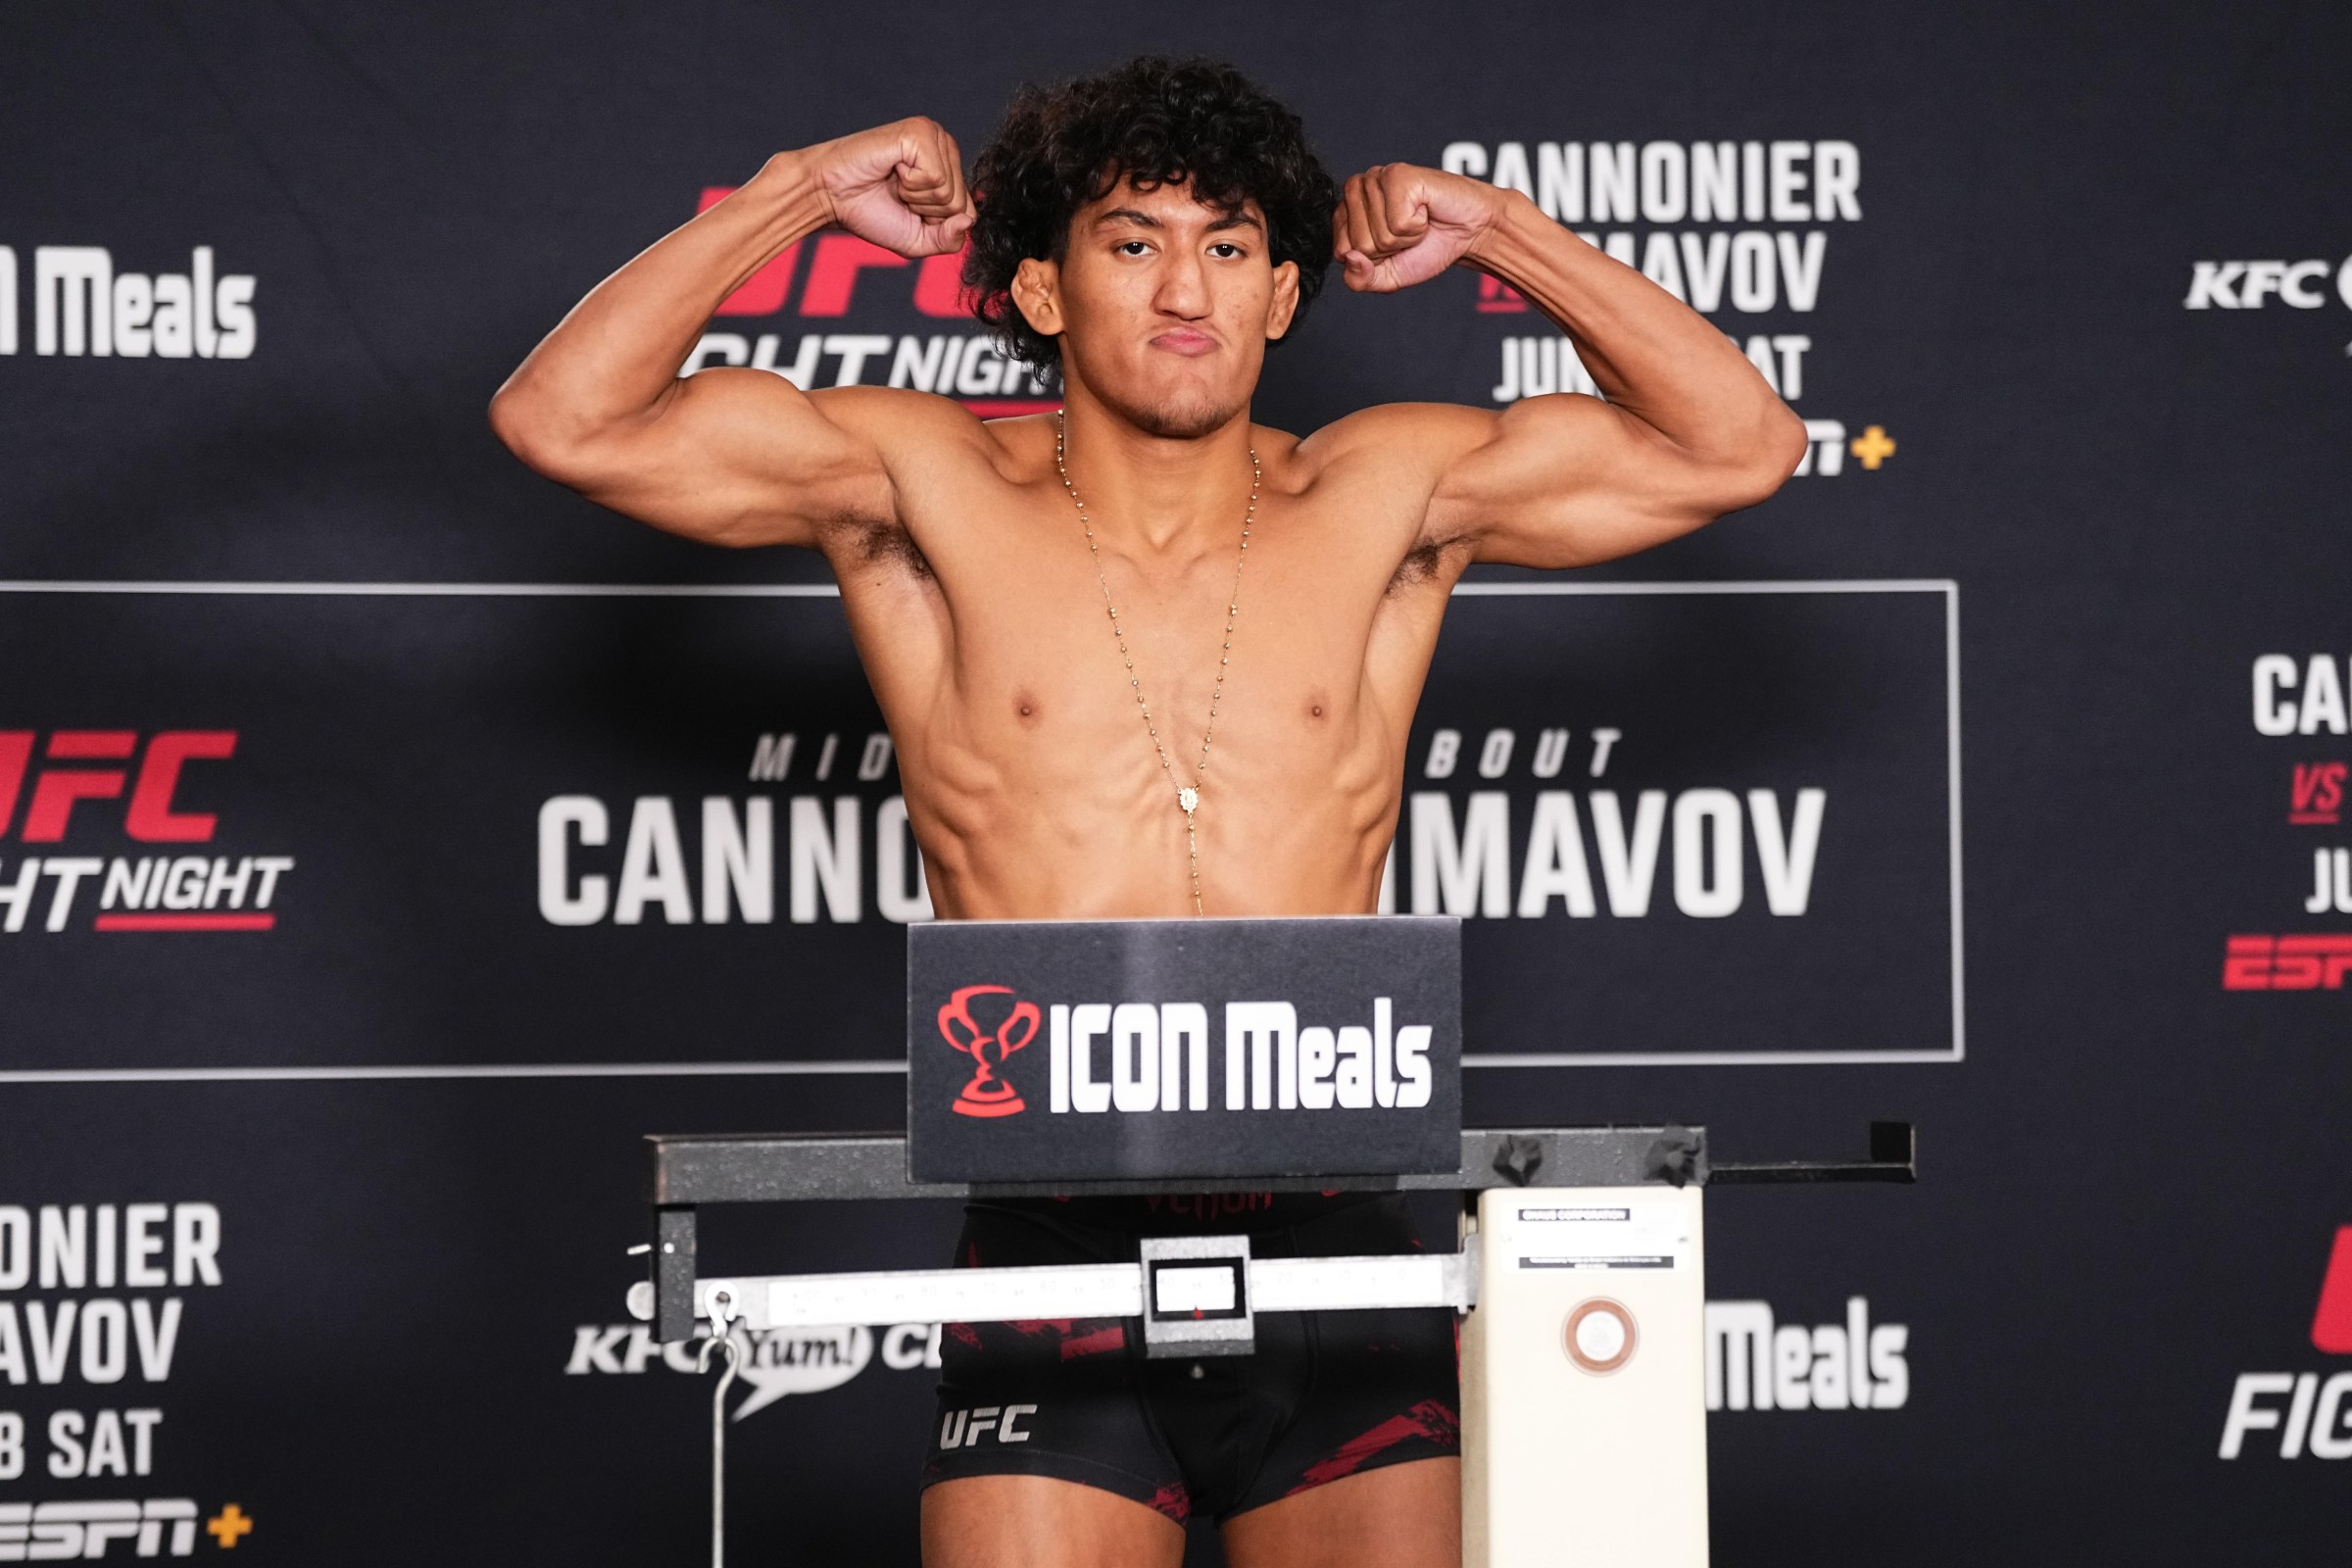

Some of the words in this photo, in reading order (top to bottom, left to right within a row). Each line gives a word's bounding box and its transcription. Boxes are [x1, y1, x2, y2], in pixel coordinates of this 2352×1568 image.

[35, 246, 256, 359] Meals
[2183, 260, 2330, 310] KFC
[1729, 334, 1812, 401] AT
[2253, 654, 2352, 735] CA
[1425, 729, 1623, 778] BOUT
[2291, 762, 2349, 811] VS
[100, 856, 294, 909] NIGHT
[1050, 1004, 1208, 1113] ICON
[1225, 997, 1433, 1110] Meals
[1704, 1298, 1909, 1411] Meals
[48, 1409, 163, 1478] SAT
[940, 1404, 1038, 1449] UFC
